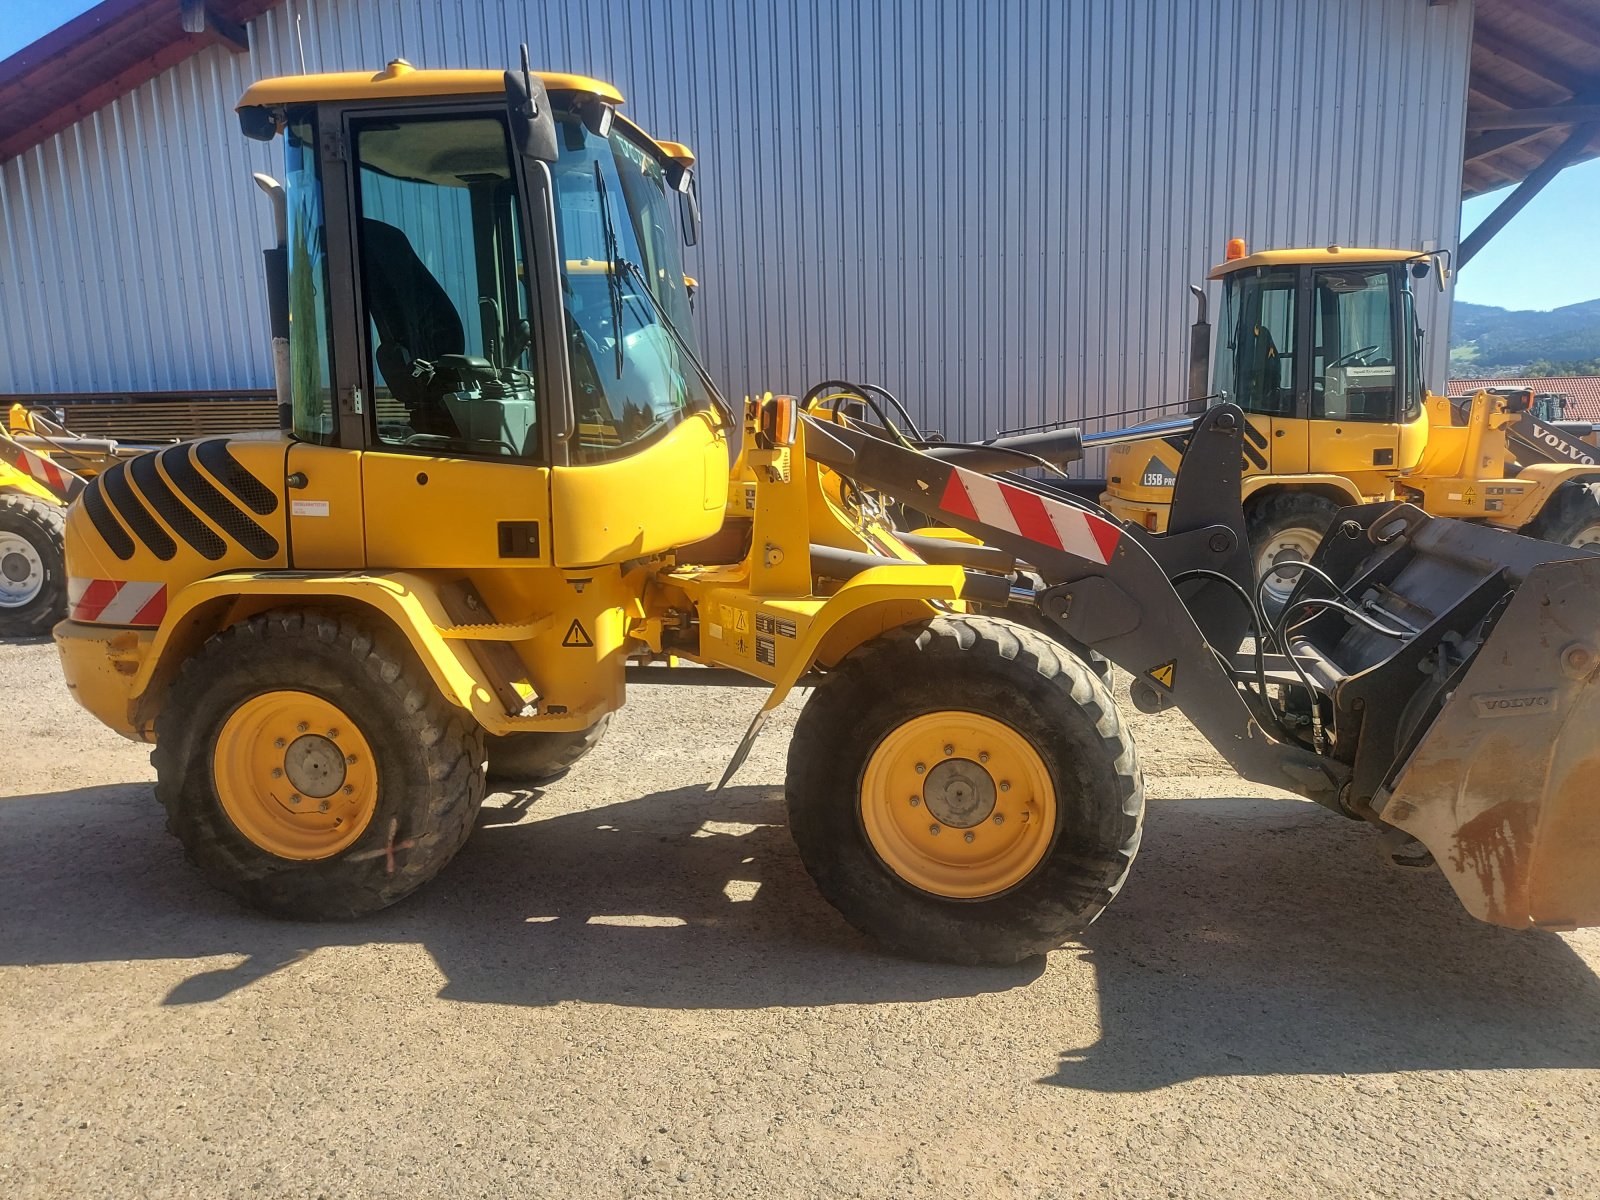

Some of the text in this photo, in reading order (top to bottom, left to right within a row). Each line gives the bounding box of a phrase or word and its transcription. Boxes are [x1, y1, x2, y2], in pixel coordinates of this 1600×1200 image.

[1533, 423, 1594, 464] VOLVO
[1144, 473, 1163, 486] L35B
[1485, 696, 1549, 709] VOLVO
